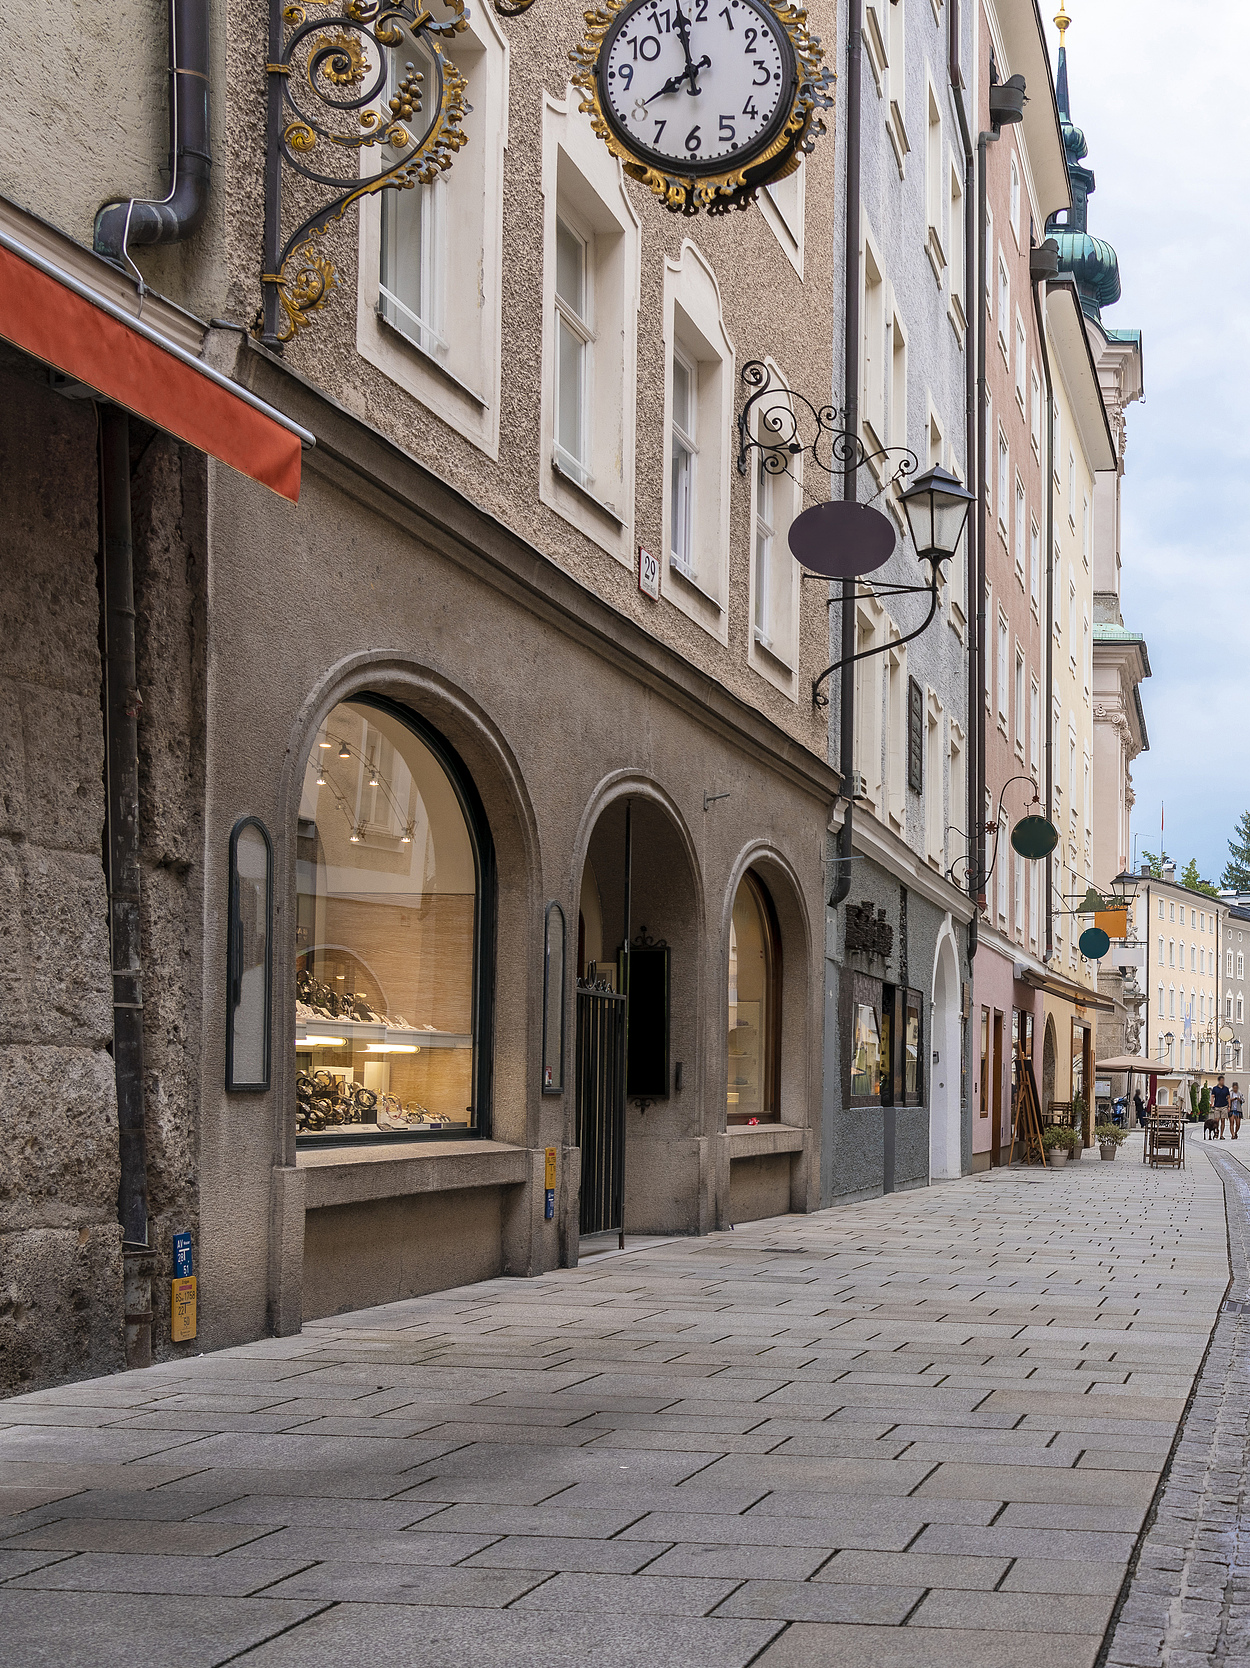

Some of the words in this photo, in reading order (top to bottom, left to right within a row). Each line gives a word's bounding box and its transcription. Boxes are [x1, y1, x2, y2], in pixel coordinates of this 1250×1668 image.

[646, 8, 671, 35] 11
[718, 6, 735, 31] 1
[626, 35, 661, 62] 10
[744, 27, 758, 54] 2
[618, 63, 634, 92] 9
[752, 60, 771, 86] 3
[631, 97, 649, 122] 8
[741, 95, 759, 120] 4
[653, 119, 668, 144] 7
[684, 124, 702, 152] 6
[718, 114, 736, 142] 5
[644, 555, 656, 583] 29
